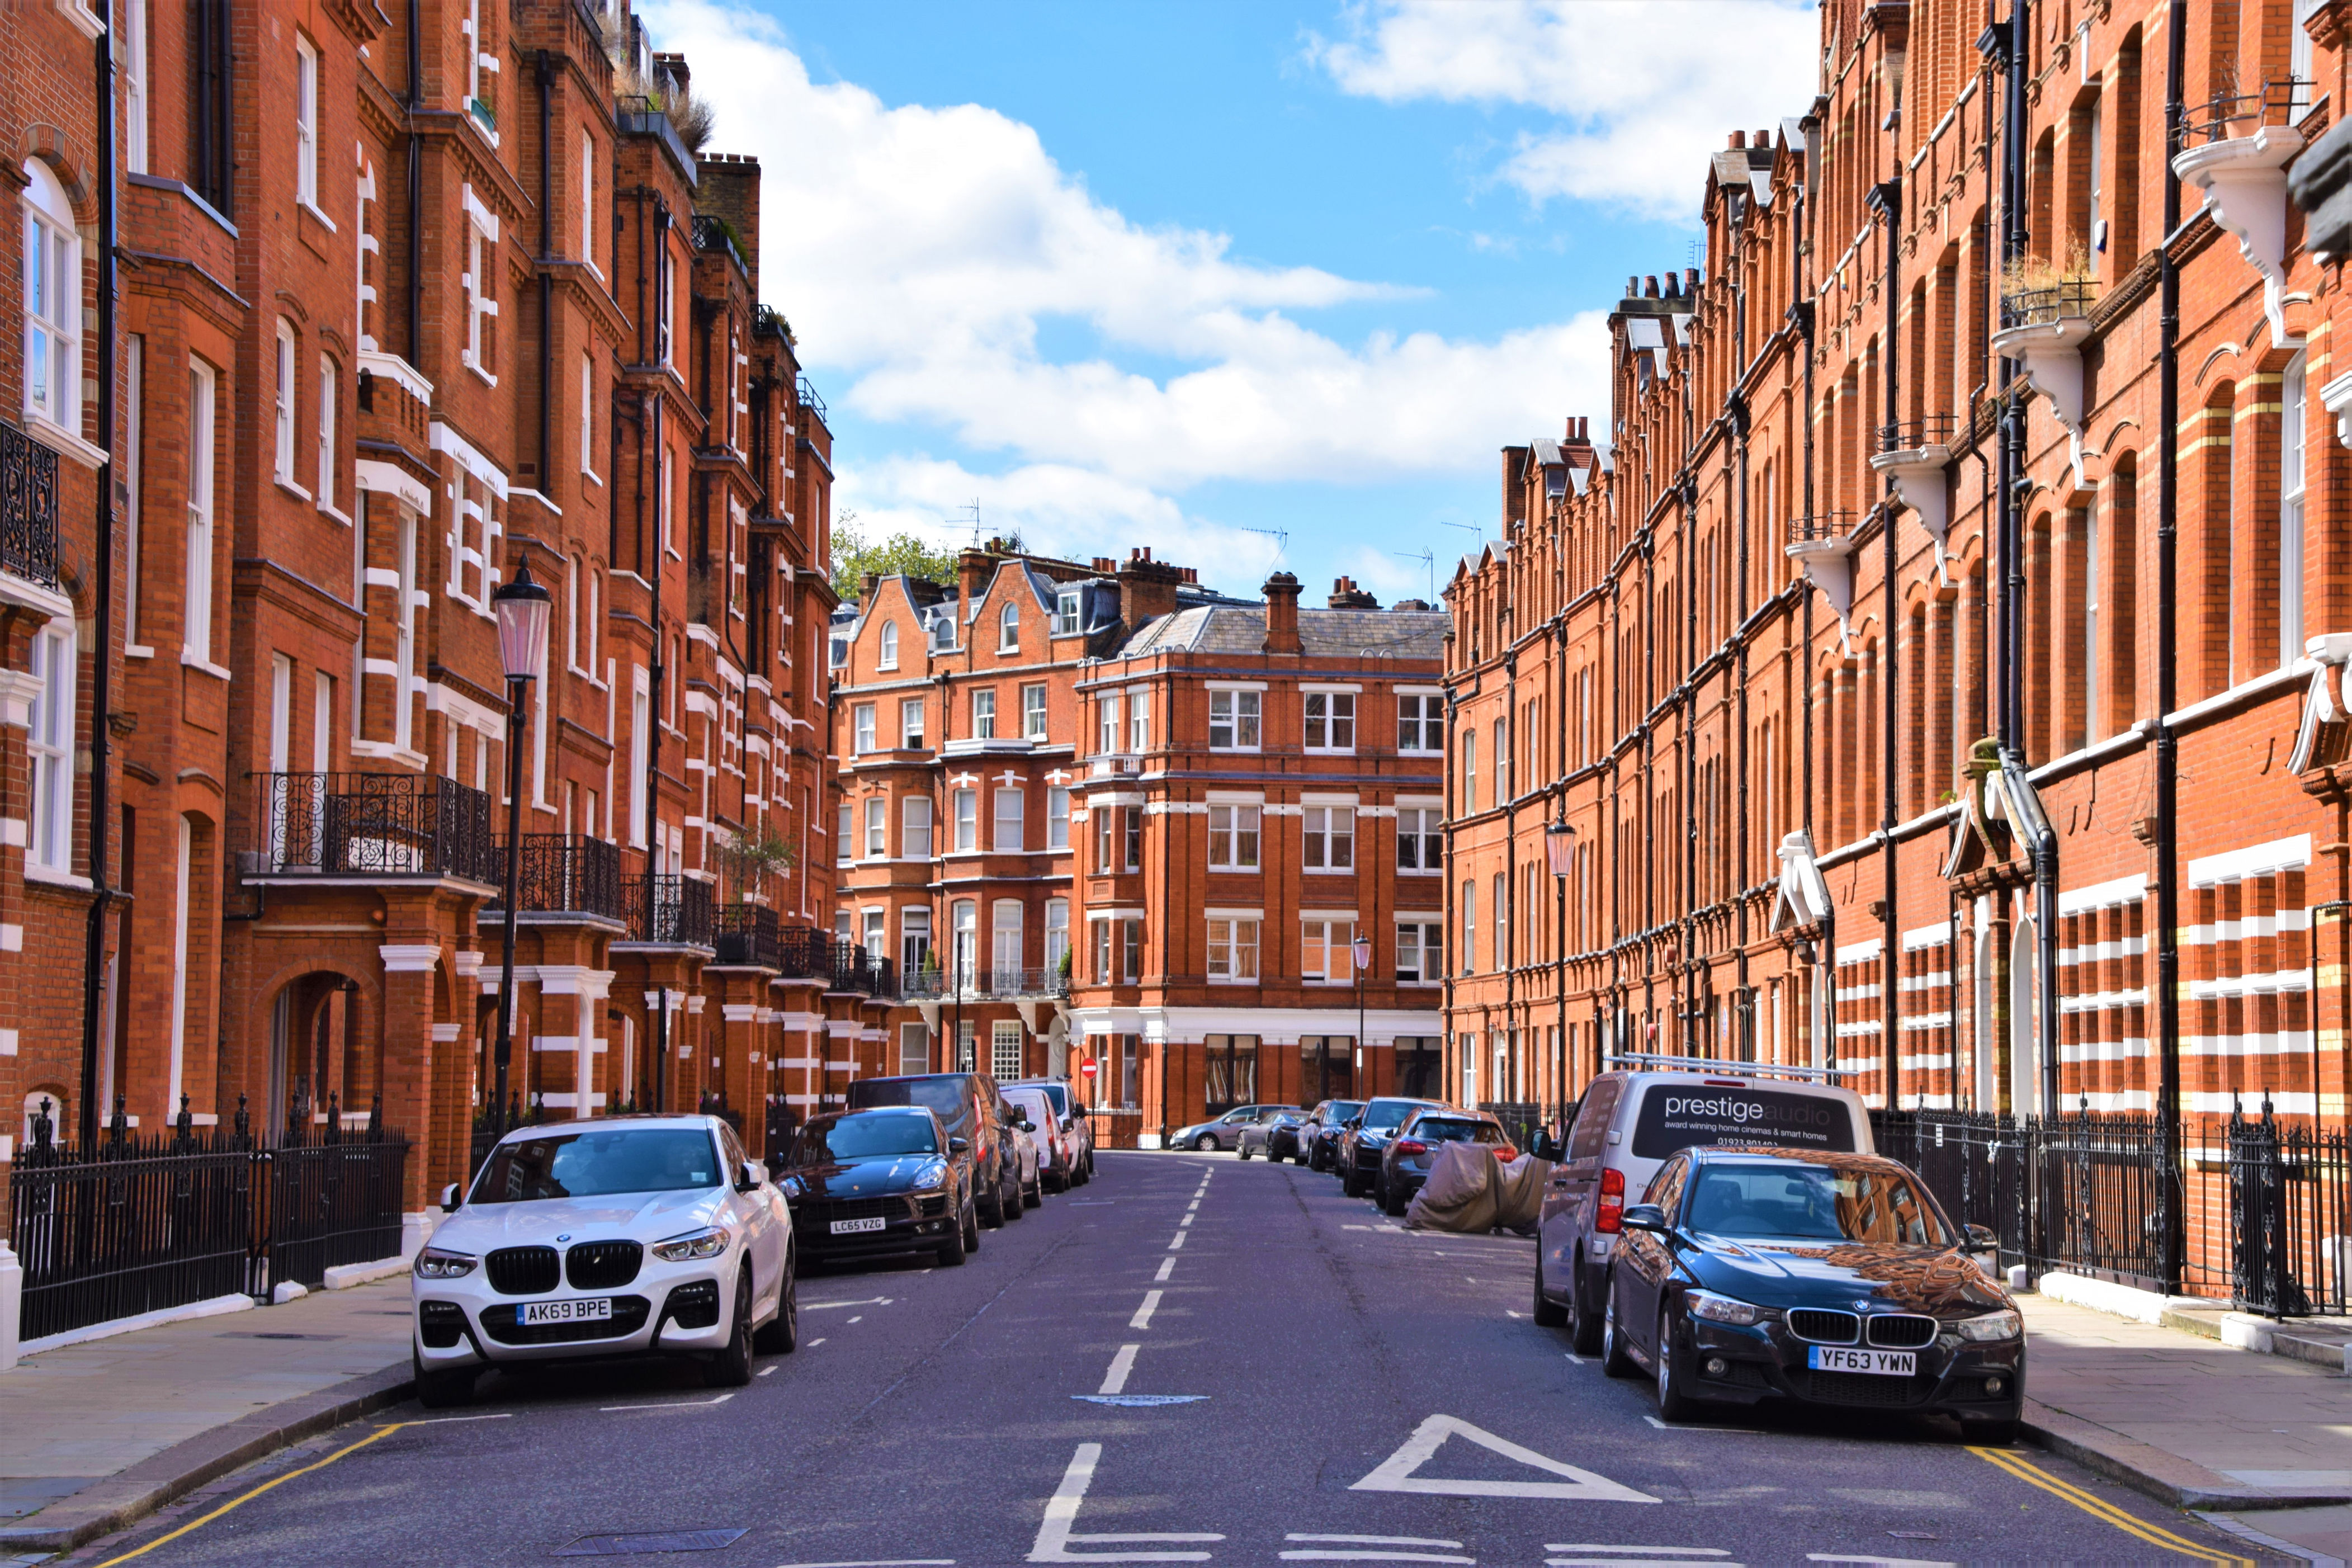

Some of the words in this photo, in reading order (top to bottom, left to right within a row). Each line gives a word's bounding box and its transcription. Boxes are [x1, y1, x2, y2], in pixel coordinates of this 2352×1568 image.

[1689, 1122, 1717, 1132] winning
[1718, 1123, 1739, 1132] home
[1741, 1125, 1771, 1135] cinemas
[1780, 1130, 1801, 1138] smart
[1802, 1131, 1827, 1141] homes
[835, 1221, 859, 1231] LC65
[863, 1219, 881, 1229] VZG
[528, 1303, 571, 1321] AK69
[576, 1300, 608, 1317] BPE
[1822, 1349, 1871, 1369] YF63
[1878, 1353, 1912, 1372] YWN
